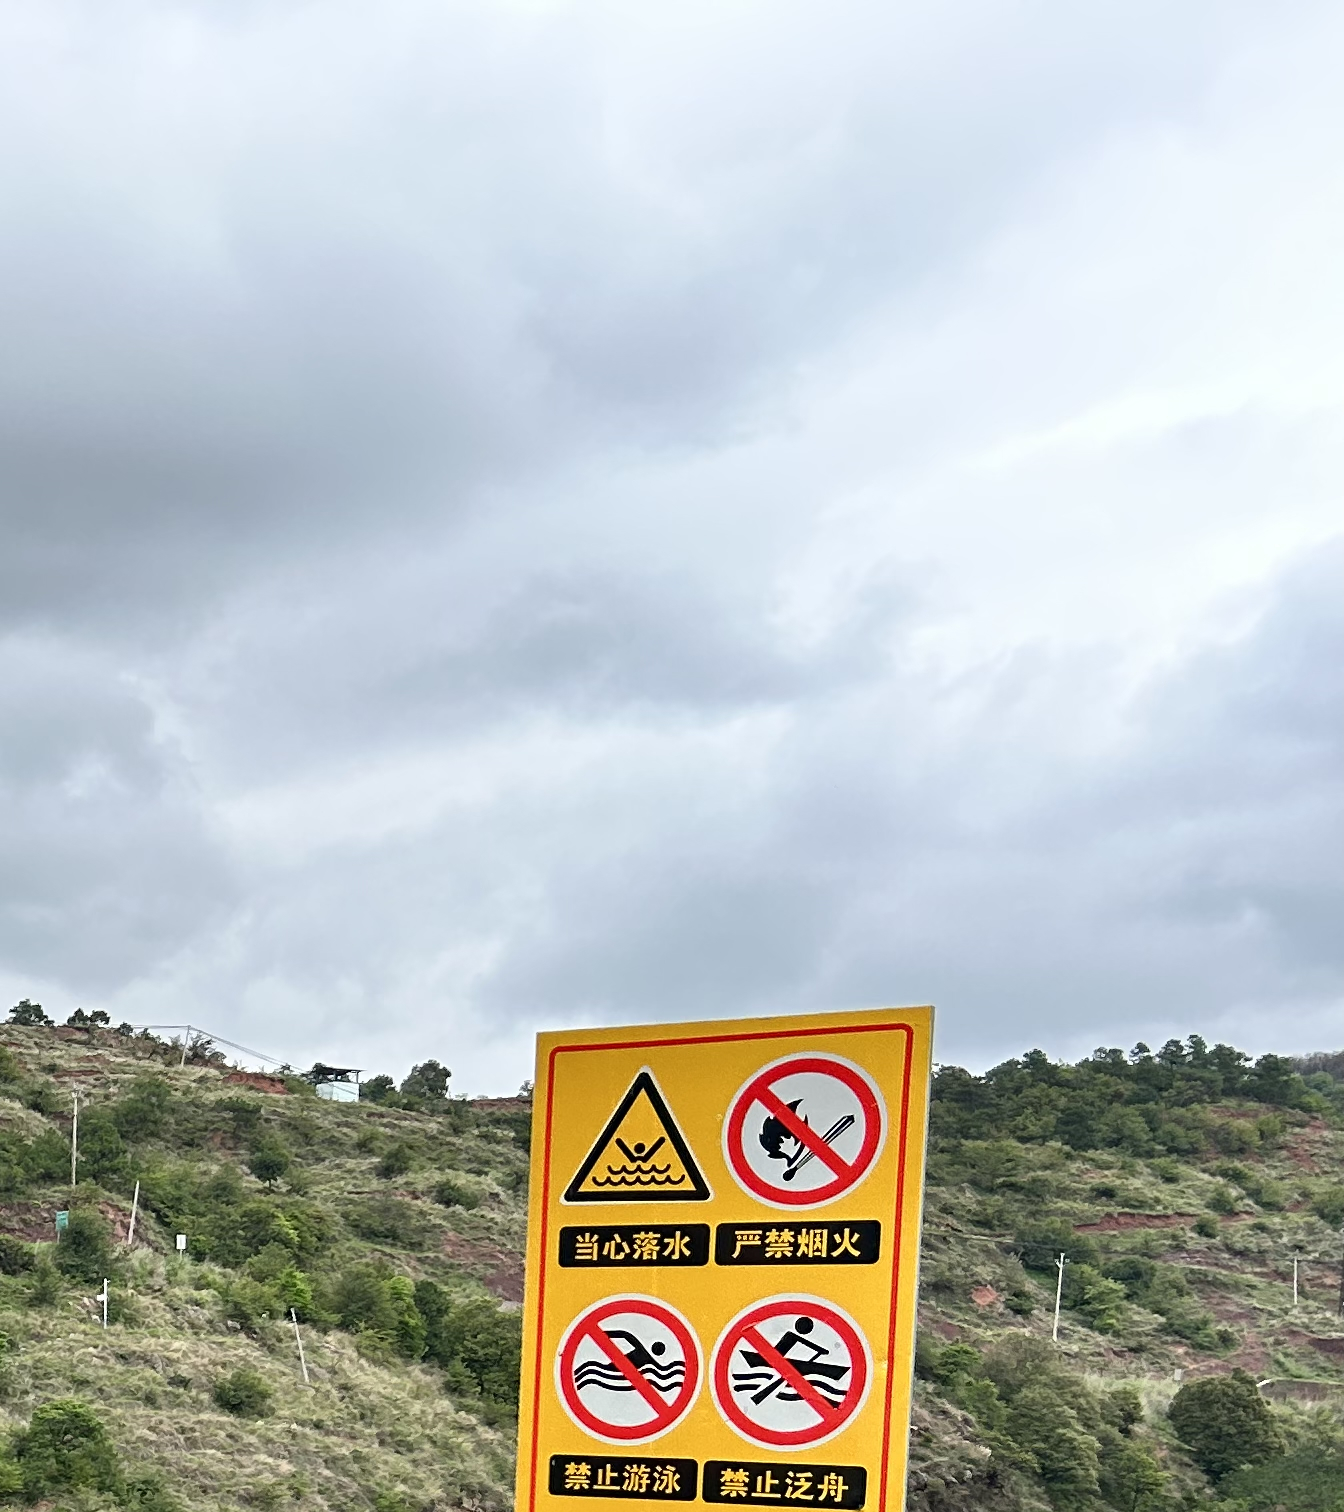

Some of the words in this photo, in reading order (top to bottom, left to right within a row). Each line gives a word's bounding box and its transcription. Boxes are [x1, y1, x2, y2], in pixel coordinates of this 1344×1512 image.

[574, 1230, 691, 1261] 当心落水
[731, 1228, 861, 1260] 严禁烟火
[564, 1462, 681, 1494] 禁止游泳
[720, 1468, 849, 1503] 禁止泛舟
